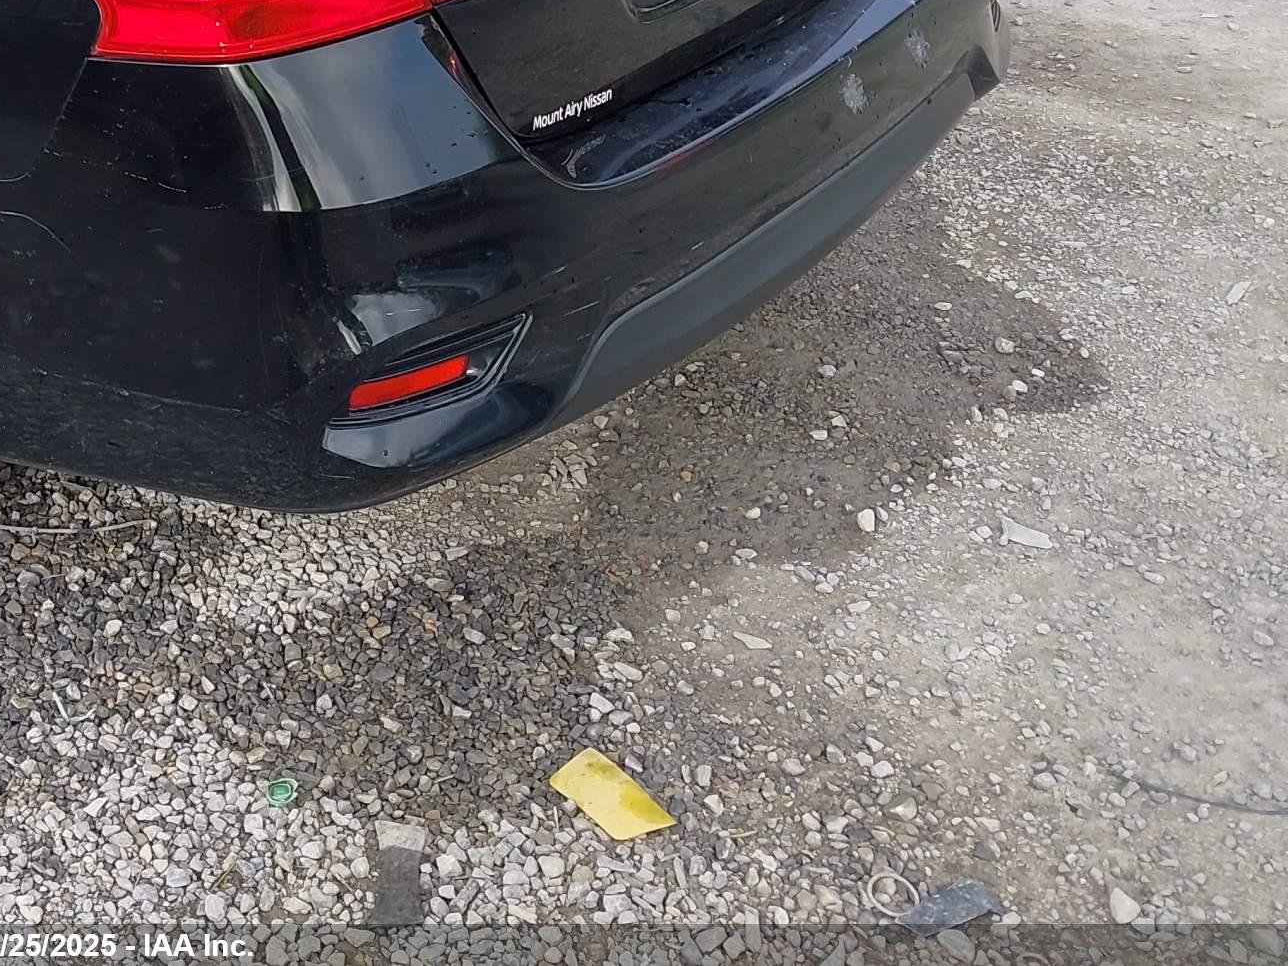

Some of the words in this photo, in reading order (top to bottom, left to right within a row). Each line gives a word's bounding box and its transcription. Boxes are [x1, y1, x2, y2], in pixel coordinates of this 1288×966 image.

[533, 107, 564, 130] Mount
[565, 100, 583, 117] Airy
[584, 88, 613, 111] Nissan
